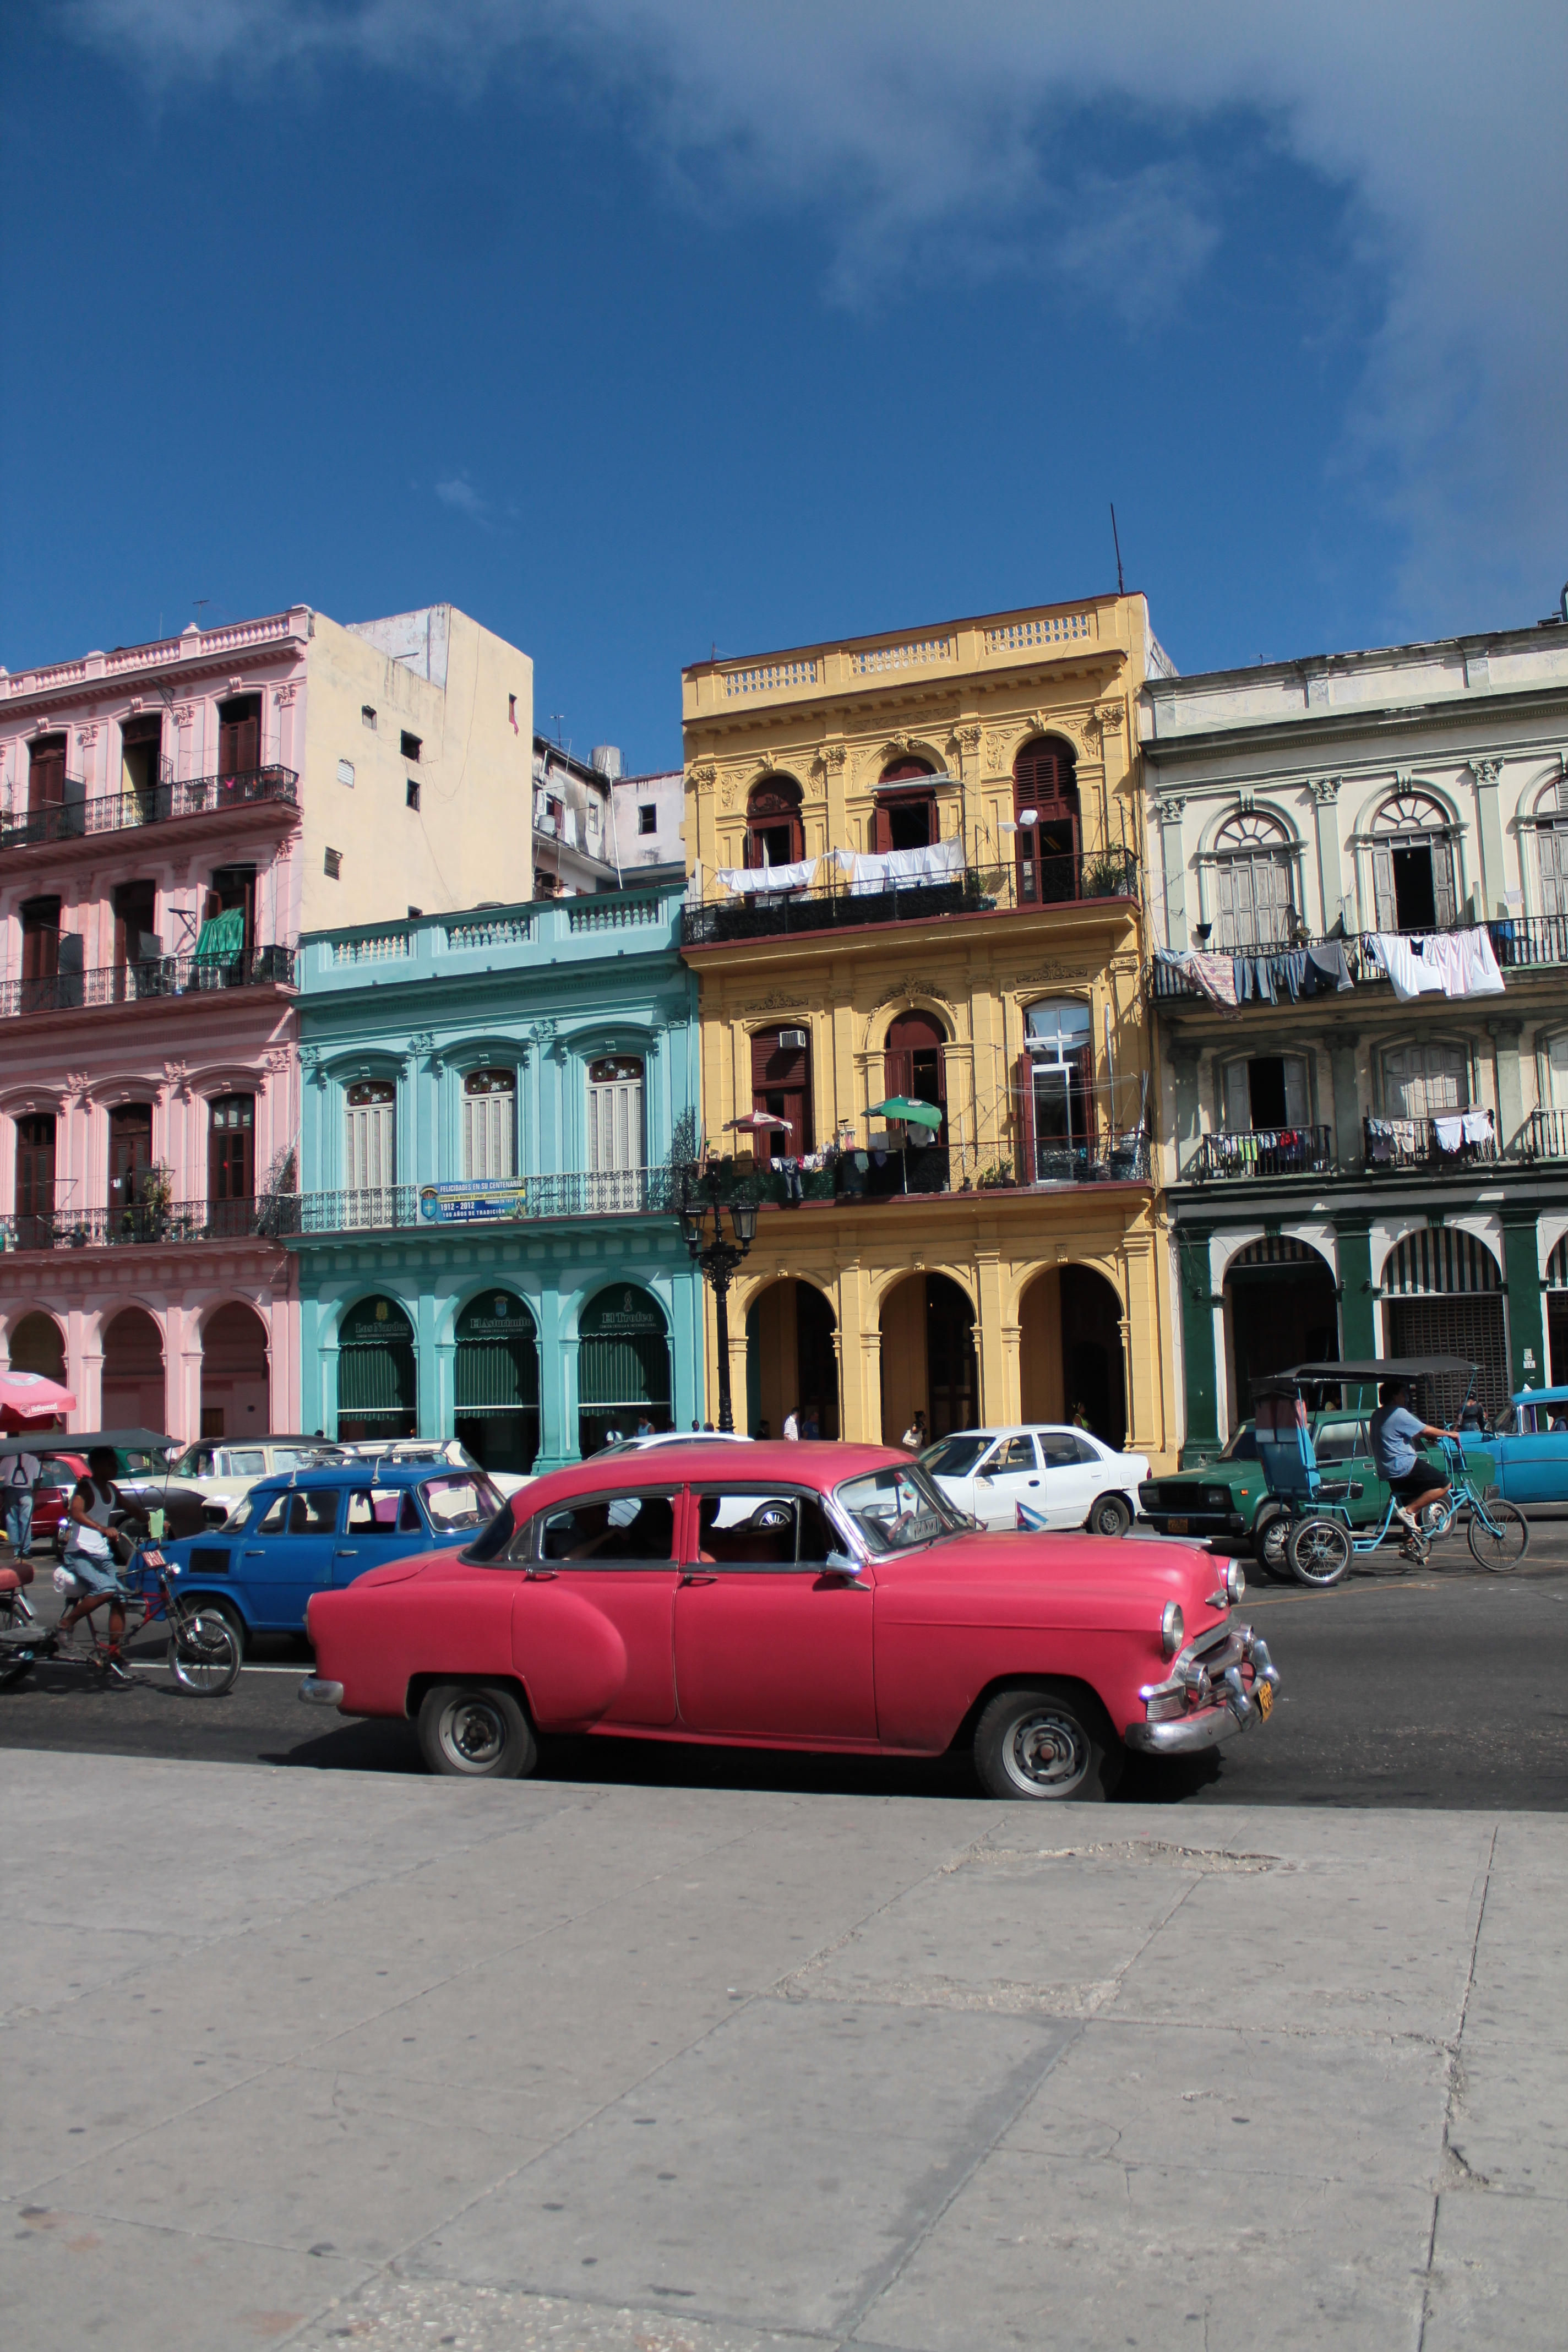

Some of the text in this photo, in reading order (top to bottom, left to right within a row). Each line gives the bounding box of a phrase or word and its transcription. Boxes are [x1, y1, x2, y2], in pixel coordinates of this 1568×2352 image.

[440, 1184, 471, 1193] FELICIDADES
[489, 1180, 522, 1189] CENTENARIO
[440, 1203, 455, 1211] 1912
[460, 1202, 475, 1210] 2012
[470, 1316, 532, 1329] El Asturianito
[602, 1311, 654, 1323] El Trofeo
[355, 1321, 409, 1333] Los Nardos
[31, 1402, 58, 1413] Hollywood
[914, 1518, 937, 1537] TAXI
[146, 1556, 166, 1566] TAXI
